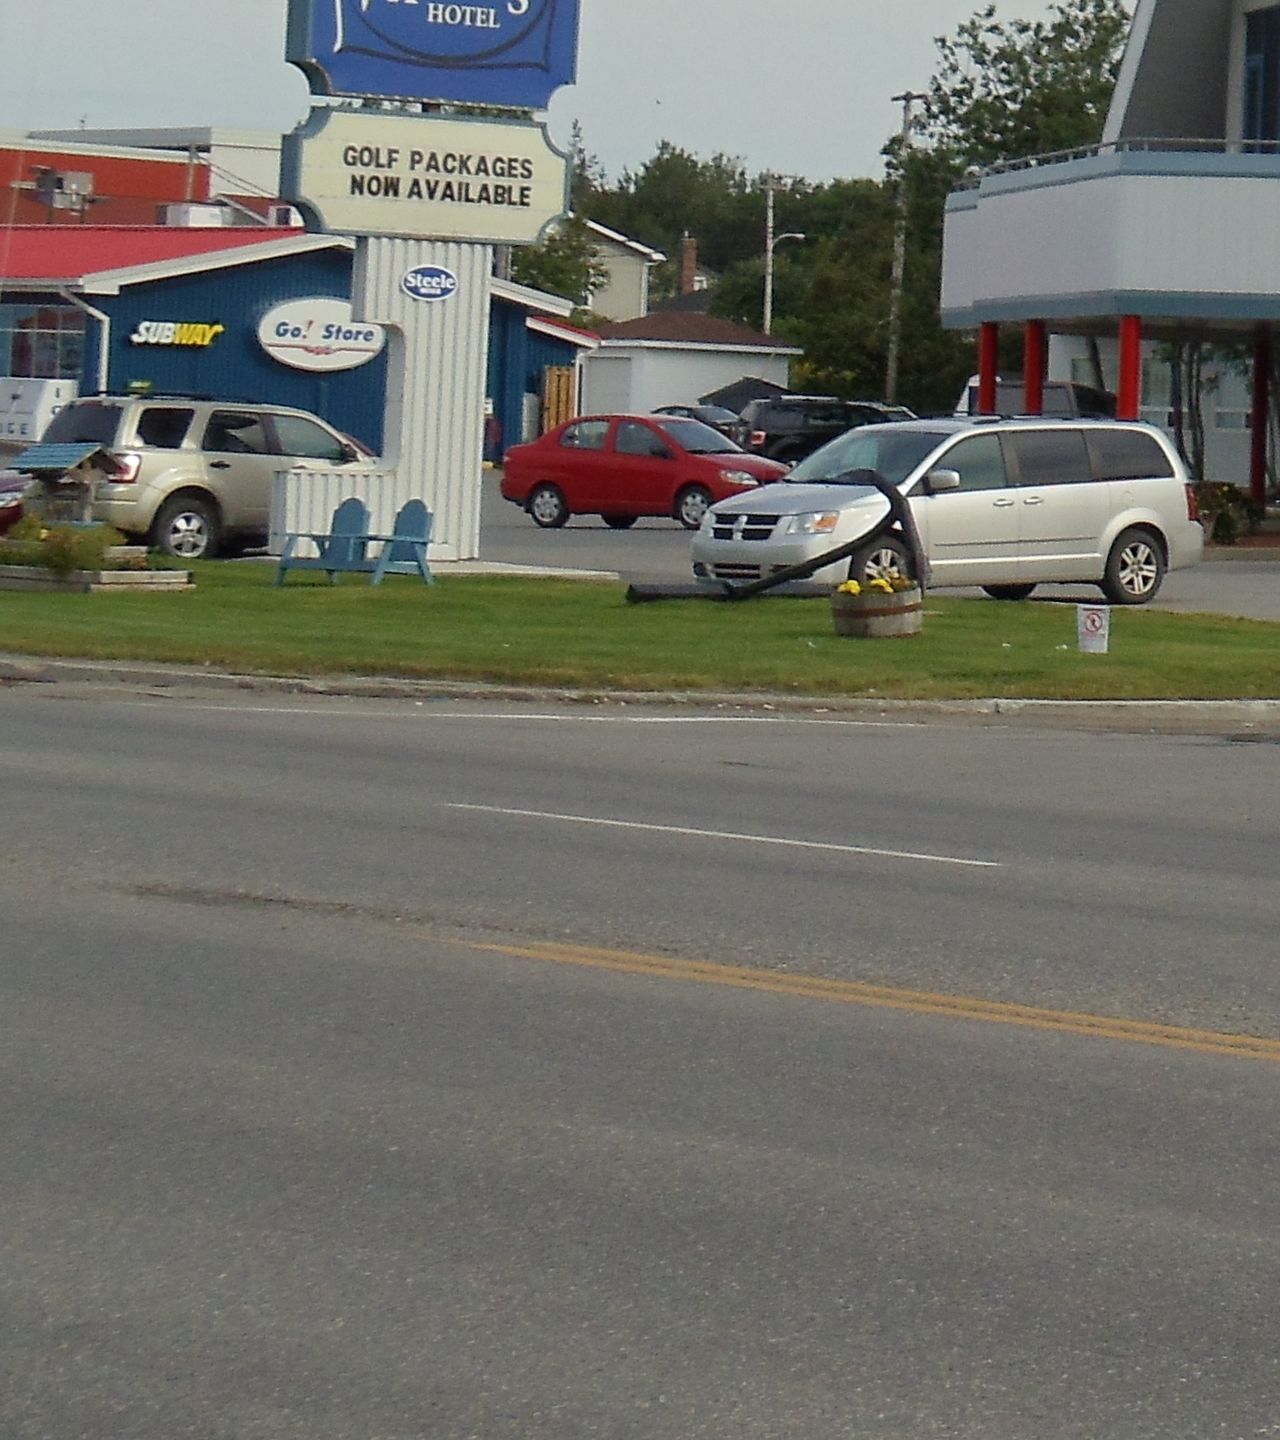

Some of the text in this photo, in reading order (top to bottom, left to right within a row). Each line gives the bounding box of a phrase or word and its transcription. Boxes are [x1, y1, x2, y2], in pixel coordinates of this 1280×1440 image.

[427, 2, 500, 28] HOTEL
[343, 145, 534, 180] GOLF PACKAGES
[350, 174, 532, 208] NOW AVAILABLE
[406, 273, 456, 289] Steele
[130, 321, 225, 346] SUBWAY
[275, 320, 375, 342] Go! Store
